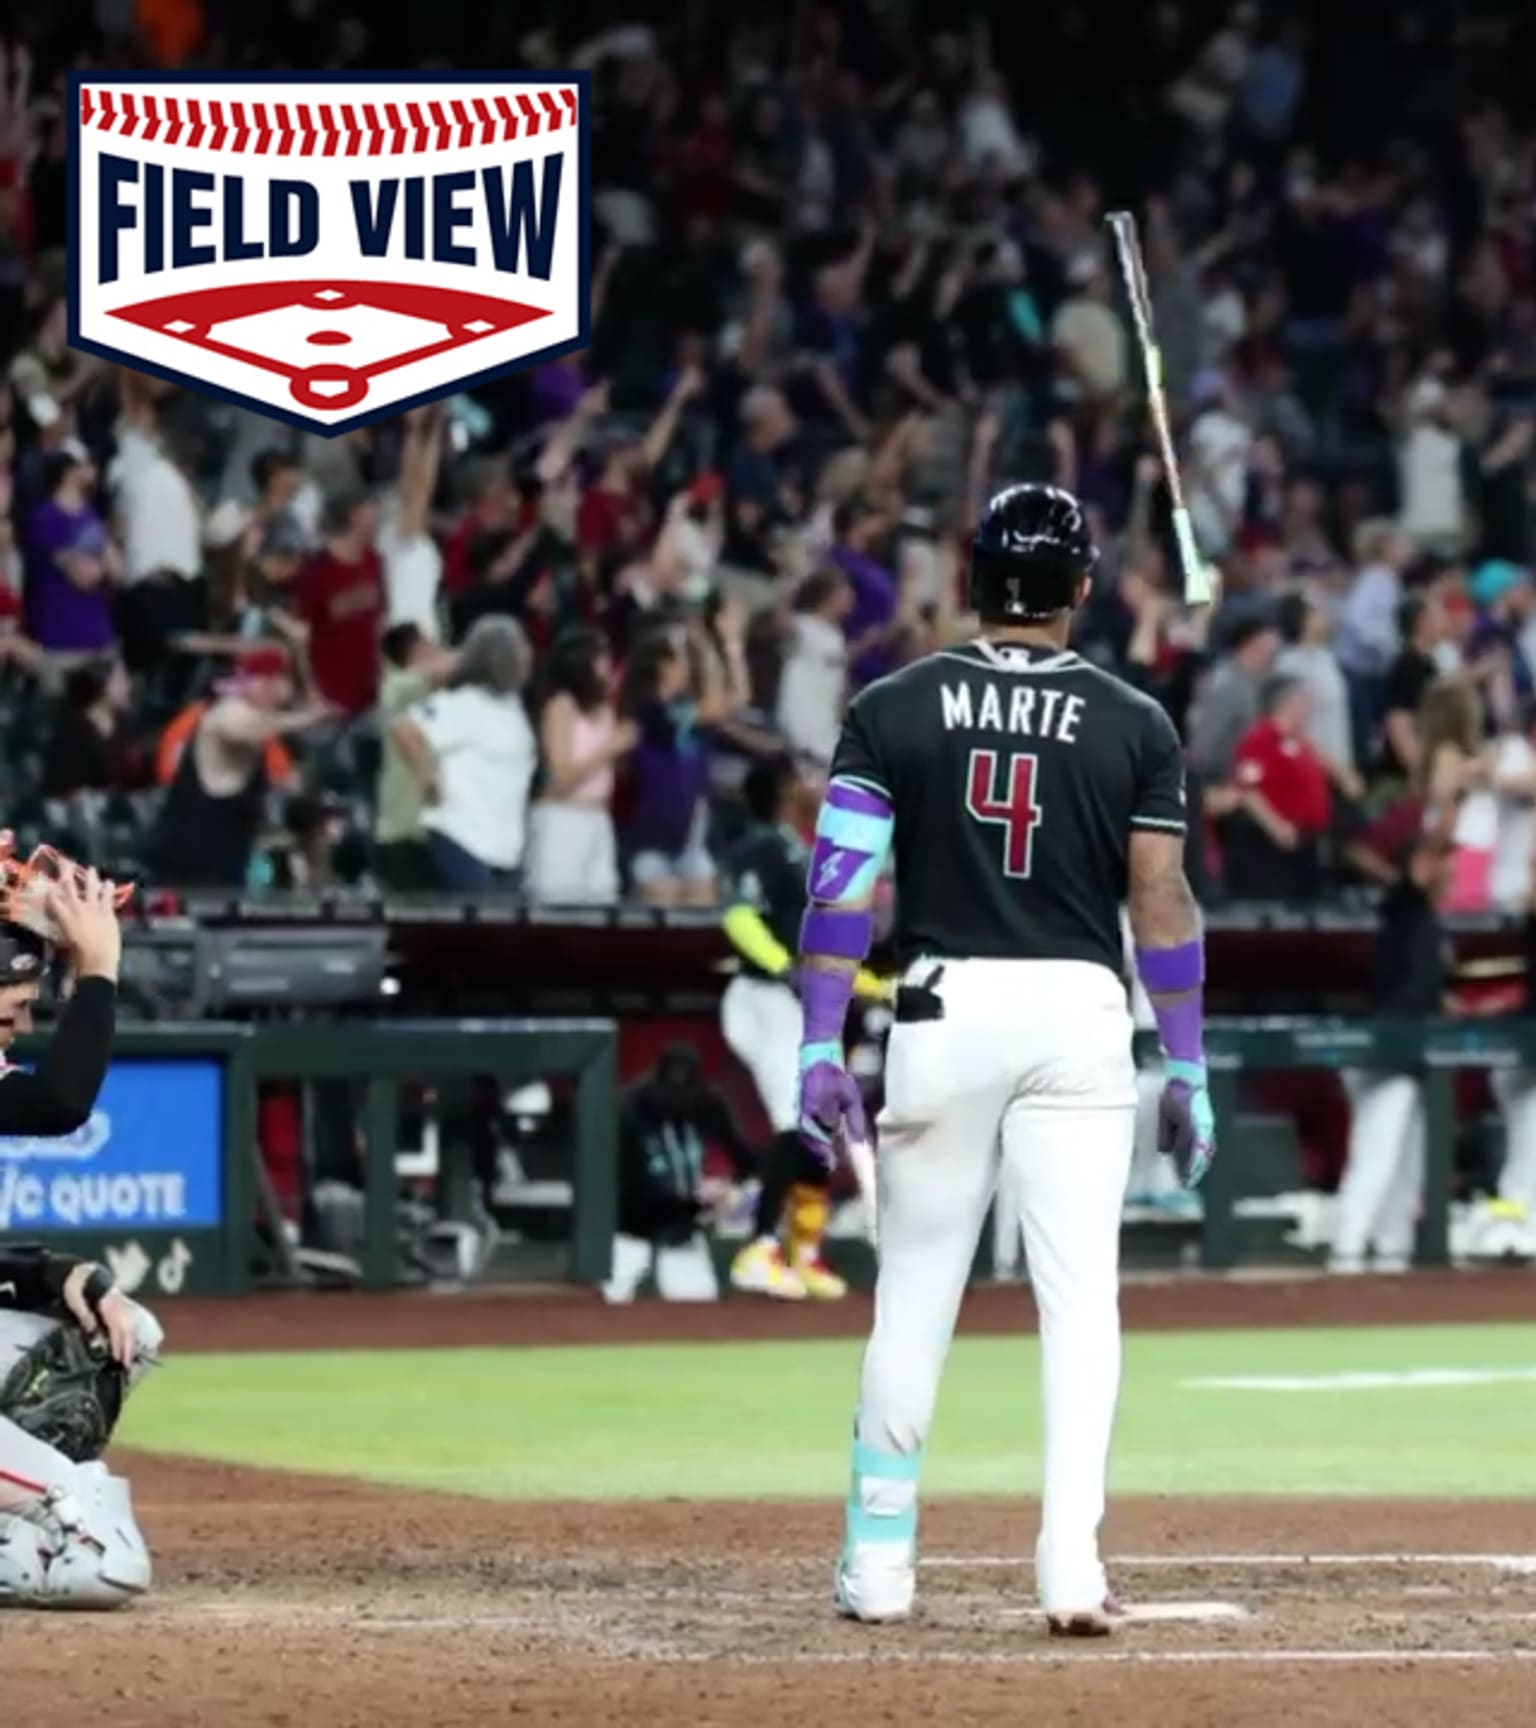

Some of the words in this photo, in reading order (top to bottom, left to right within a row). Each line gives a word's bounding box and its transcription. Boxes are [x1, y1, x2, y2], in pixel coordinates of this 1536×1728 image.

[940, 681, 1086, 743] MARTE
[965, 748, 1042, 878] 4
[51, 1172, 187, 1226] QUOTE
